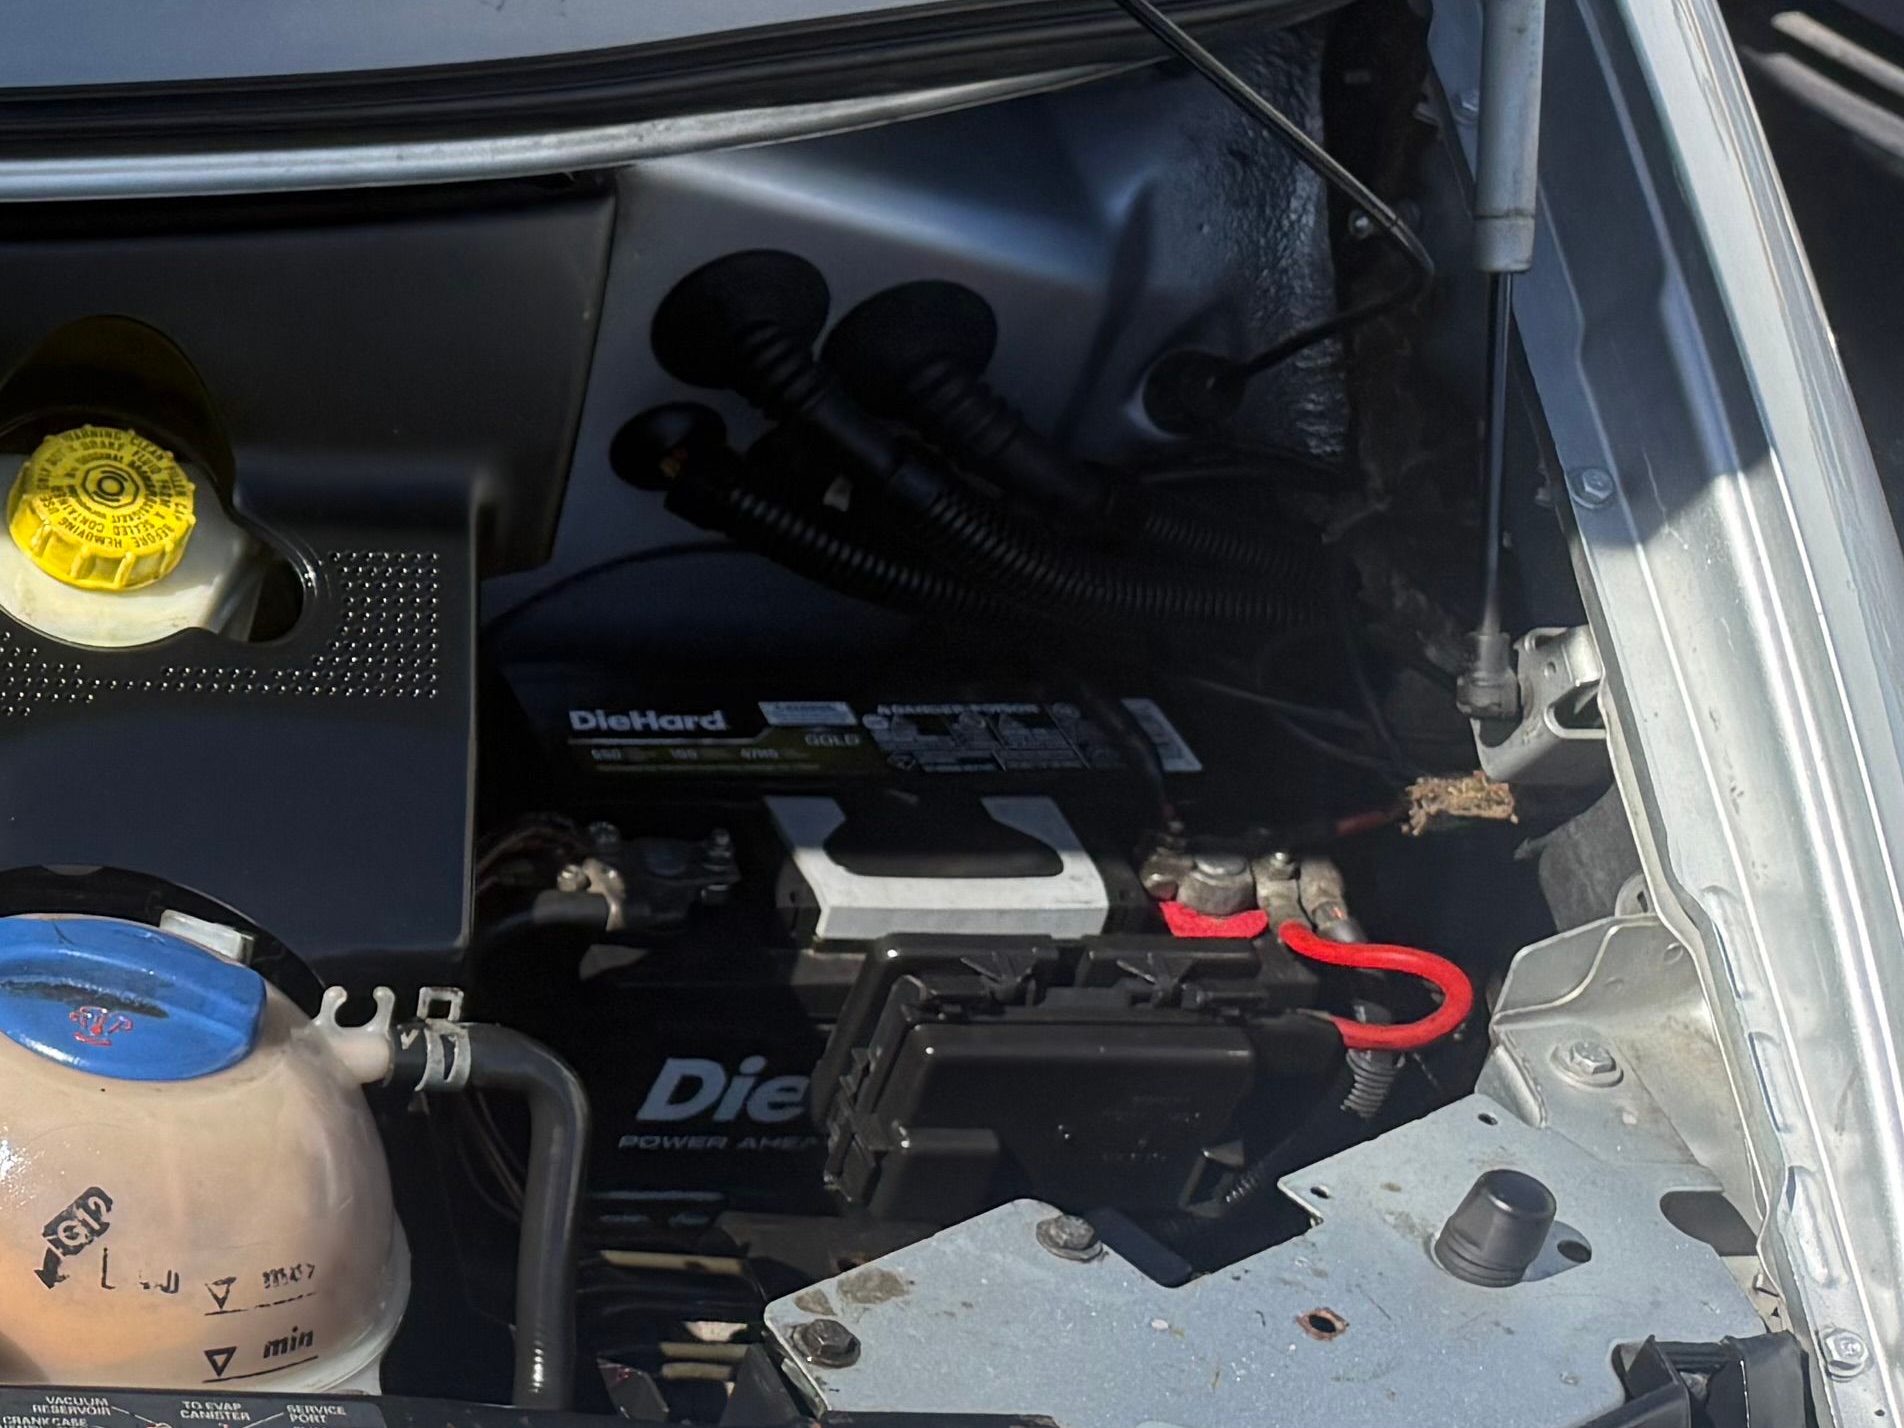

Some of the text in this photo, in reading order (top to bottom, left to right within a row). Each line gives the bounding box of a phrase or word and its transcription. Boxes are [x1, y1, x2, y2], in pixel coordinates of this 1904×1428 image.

[131, 436, 164, 461] CLEAN
[132, 450, 162, 475] FLUID
[40, 496, 60, 515] USE
[134, 524, 175, 548] BEFORE
[568, 709, 729, 732] DieHard
[636, 1055, 811, 1122] Die
[618, 1135, 728, 1150] POWER
[263, 1325, 314, 1359] min
[32, 1404, 112, 1416] RESERVOIR
[45, 1396, 109, 1406] VACUUM
[183, 1401, 202, 1410] TO
[286, 1404, 346, 1415] SERVICE
